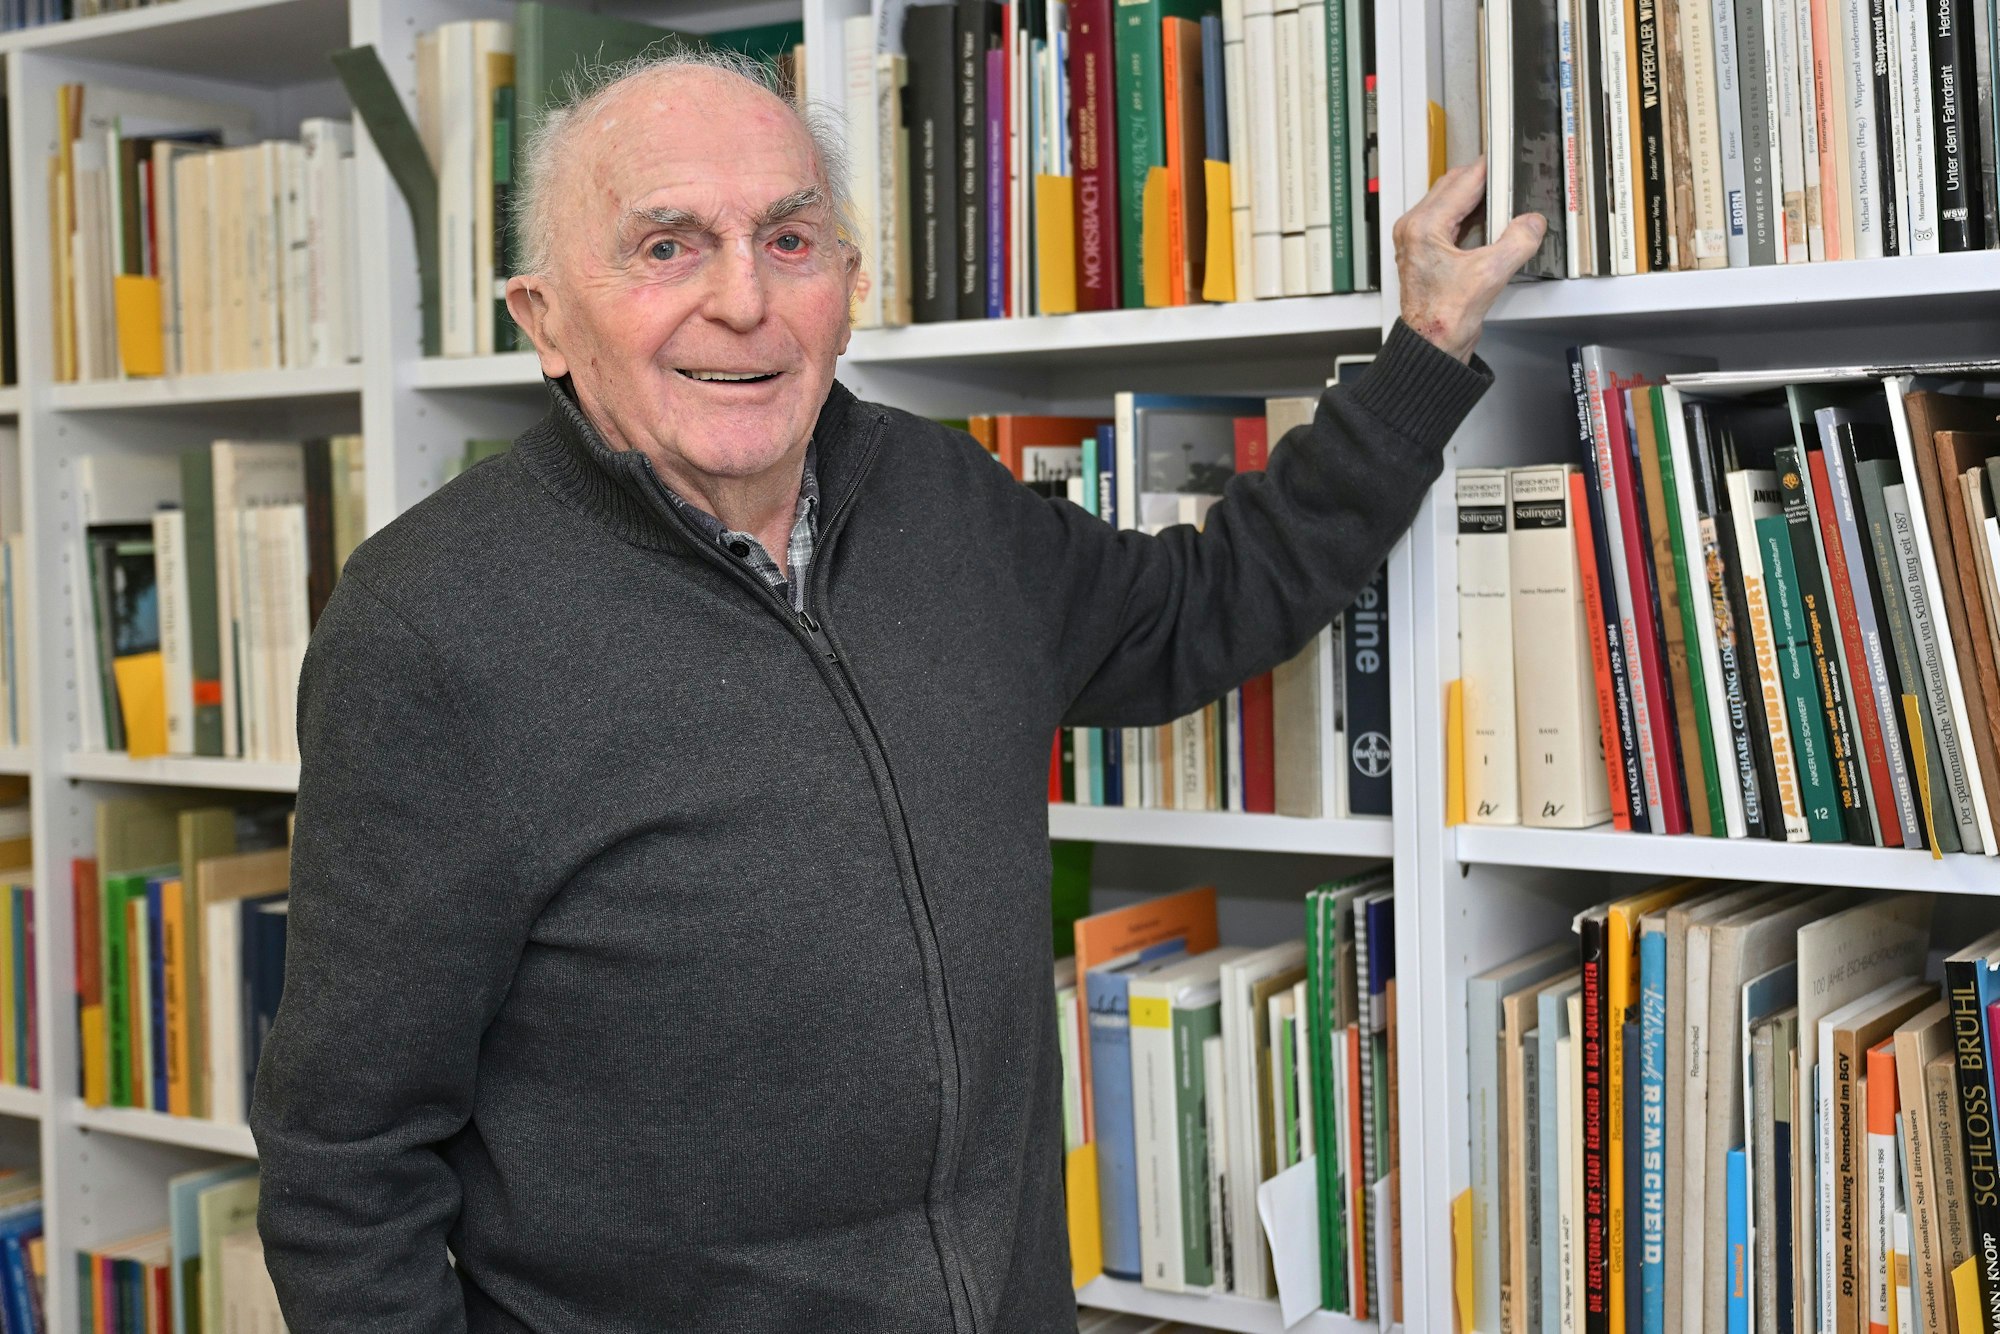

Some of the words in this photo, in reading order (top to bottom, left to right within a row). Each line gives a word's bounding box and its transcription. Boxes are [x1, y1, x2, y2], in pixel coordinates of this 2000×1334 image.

[1720, 25, 1728, 42] und
[1872, 16, 1887, 76] Wuppertal
[1909, 21, 1917, 51] Eisenbahn
[1641, 24, 1658, 108] WUPPERTALER
[1720, 44, 1730, 64] Geld
[1747, 25, 1756, 80] ARBEITER
[1723, 66, 1733, 90] Garn,
[1852, 62, 1865, 109] Wuppertal
[1941, 64, 1956, 122] Fahrdraht
[1565, 92, 1573, 112] dem
[1750, 86, 1759, 118] SEINE
[1615, 116, 1624, 160] Hakenkreuz
[1728, 131, 1737, 159] Krause
[1752, 124, 1760, 148] UND
[1855, 116, 1868, 148] (Hrsg.)
[1943, 126, 1958, 153] dem
[1565, 137, 1577, 212] Stadtansichten
[1617, 163, 1625, 182] Unter
[1754, 154, 1762, 171] CO.
[1857, 150, 1869, 194] Metschies
[1944, 157, 1960, 191] Unter
[1731, 192, 1743, 225] BORN
[1756, 190, 1766, 244] VORWERK
[1860, 197, 1871, 233] Michael
[1943, 209, 1967, 218] WSW
[1082, 176, 1101, 288] MORSBACH
[1571, 362, 1583, 394] Verlag
[1588, 369, 1601, 419] VERLAG
[1576, 395, 1589, 440] Wartberg
[1595, 423, 1612, 489] WARTBERG
[1828, 424, 1840, 466] Sammlungen
[1514, 478, 1560, 487] GESCHICHTE
[1835, 467, 1843, 478] die
[1480, 491, 1502, 499] STADT
[1515, 486, 1535, 494] EINER
[1537, 485, 1560, 493] STADT
[1838, 480, 1848, 498] durch
[1459, 512, 1503, 524] Solingen
[1516, 507, 1561, 520] Solingen
[1843, 499, 1852, 521] Führer
[1894, 511, 1910, 534] 1887
[1769, 538, 1782, 578] Reichtum?
[1900, 537, 1913, 555] seit
[1906, 556, 1921, 581] Burg
[1777, 579, 1790, 607] einziger
[1805, 594, 1815, 609] eG
[1910, 584, 1928, 618] Schloß
[1744, 575, 1775, 681] SCHWERT
[1781, 608, 1792, 629] unser
[1809, 610, 1824, 655] Solingen
[1847, 624, 1858, 639] die
[1919, 620, 1931, 640] von
[1623, 618, 1640, 680] SOLINGEN
[1787, 636, 1800, 679] Gesundheit
[1851, 642, 1862, 660] und
[1867, 631, 1885, 682] SOLINGEN
[1818, 657, 1834, 708] Bauverein
[1829, 661, 1837, 674] plus
[1856, 664, 1868, 690] Land
[1924, 642, 1950, 714] Wiederaufbau
[1634, 684, 1644, 703] alte
[1728, 672, 1745, 729] CUTTING
[1832, 675, 1842, 702] Wohnen
[1615, 676, 1634, 750] Großstadtjahre
[1637, 707, 1647, 725] das
[1765, 685, 1785, 734] UND
[1797, 696, 1811, 738] SCHWERT
[1827, 710, 1838, 730] und
[1837, 706, 1847, 731] wohnen
[1861, 693, 1878, 739] Bergische
[1640, 729, 1651, 752] über
[1842, 732, 1852, 756] Würdig
[1879, 685, 1904, 774] KLINGENMUSEUM
[1545, 753, 1553, 764] II
[1805, 739, 1815, 756] UND
[1833, 732, 1844, 758] Spar-
[1871, 743, 1883, 763] Das
[1808, 757, 1820, 787] ANKER
[1837, 760, 1850, 788] Jahre
[1847, 760, 1857, 786] wohnen
[1940, 717, 1970, 804] spätromantische
[1626, 757, 1643, 816] SOLINGEN
[1644, 757, 1659, 806] Rundflug
[1775, 737, 1798, 818] ANKER
[1814, 807, 1828, 819] 12
[1842, 789, 1853, 808] 100
[1852, 788, 1861, 808] Besser
[1897, 776, 1917, 833] DEUTSCHES
[1960, 808, 1973, 825] Der
[1584, 962, 1599, 1067] BILD-DOKUMENTEN
[1951, 980, 1984, 1069] BRÜHL
[1690, 1025, 1700, 1077] Remscheid
[1586, 1071, 1599, 1084] IN
[1839, 1053, 1850, 1081] BGV
[1839, 1085, 1850, 1100] im
[1587, 1087, 1599, 1150] REMSCHEID
[1840, 1103, 1851, 1173] Remscheid
[1909, 1109, 1924, 1178] Lüttringhausen
[1963, 1084, 1999, 1206] SCHLOSS
[1587, 1154, 1600, 1188] STADT
[1643, 1084, 1661, 1264] REMSCHEID
[1587, 1191, 1601, 1214] DER
[1841, 1176, 1853, 1240] Abteilung
[1916, 1181, 1926, 1205] Stadt
[1920, 1208, 1931, 1259] ehemaligen
[1612, 1247, 1622, 1273] Gerd
[1842, 1244, 1855, 1279] Jahre
[1924, 1262, 1933, 1278] der
[1984, 1232, 2000, 1280] KNOPP
[1843, 1280, 1853, 1297] 50
[1589, 1295, 1602, 1313] DIE
[1926, 1280, 1938, 1328] Geschichte
